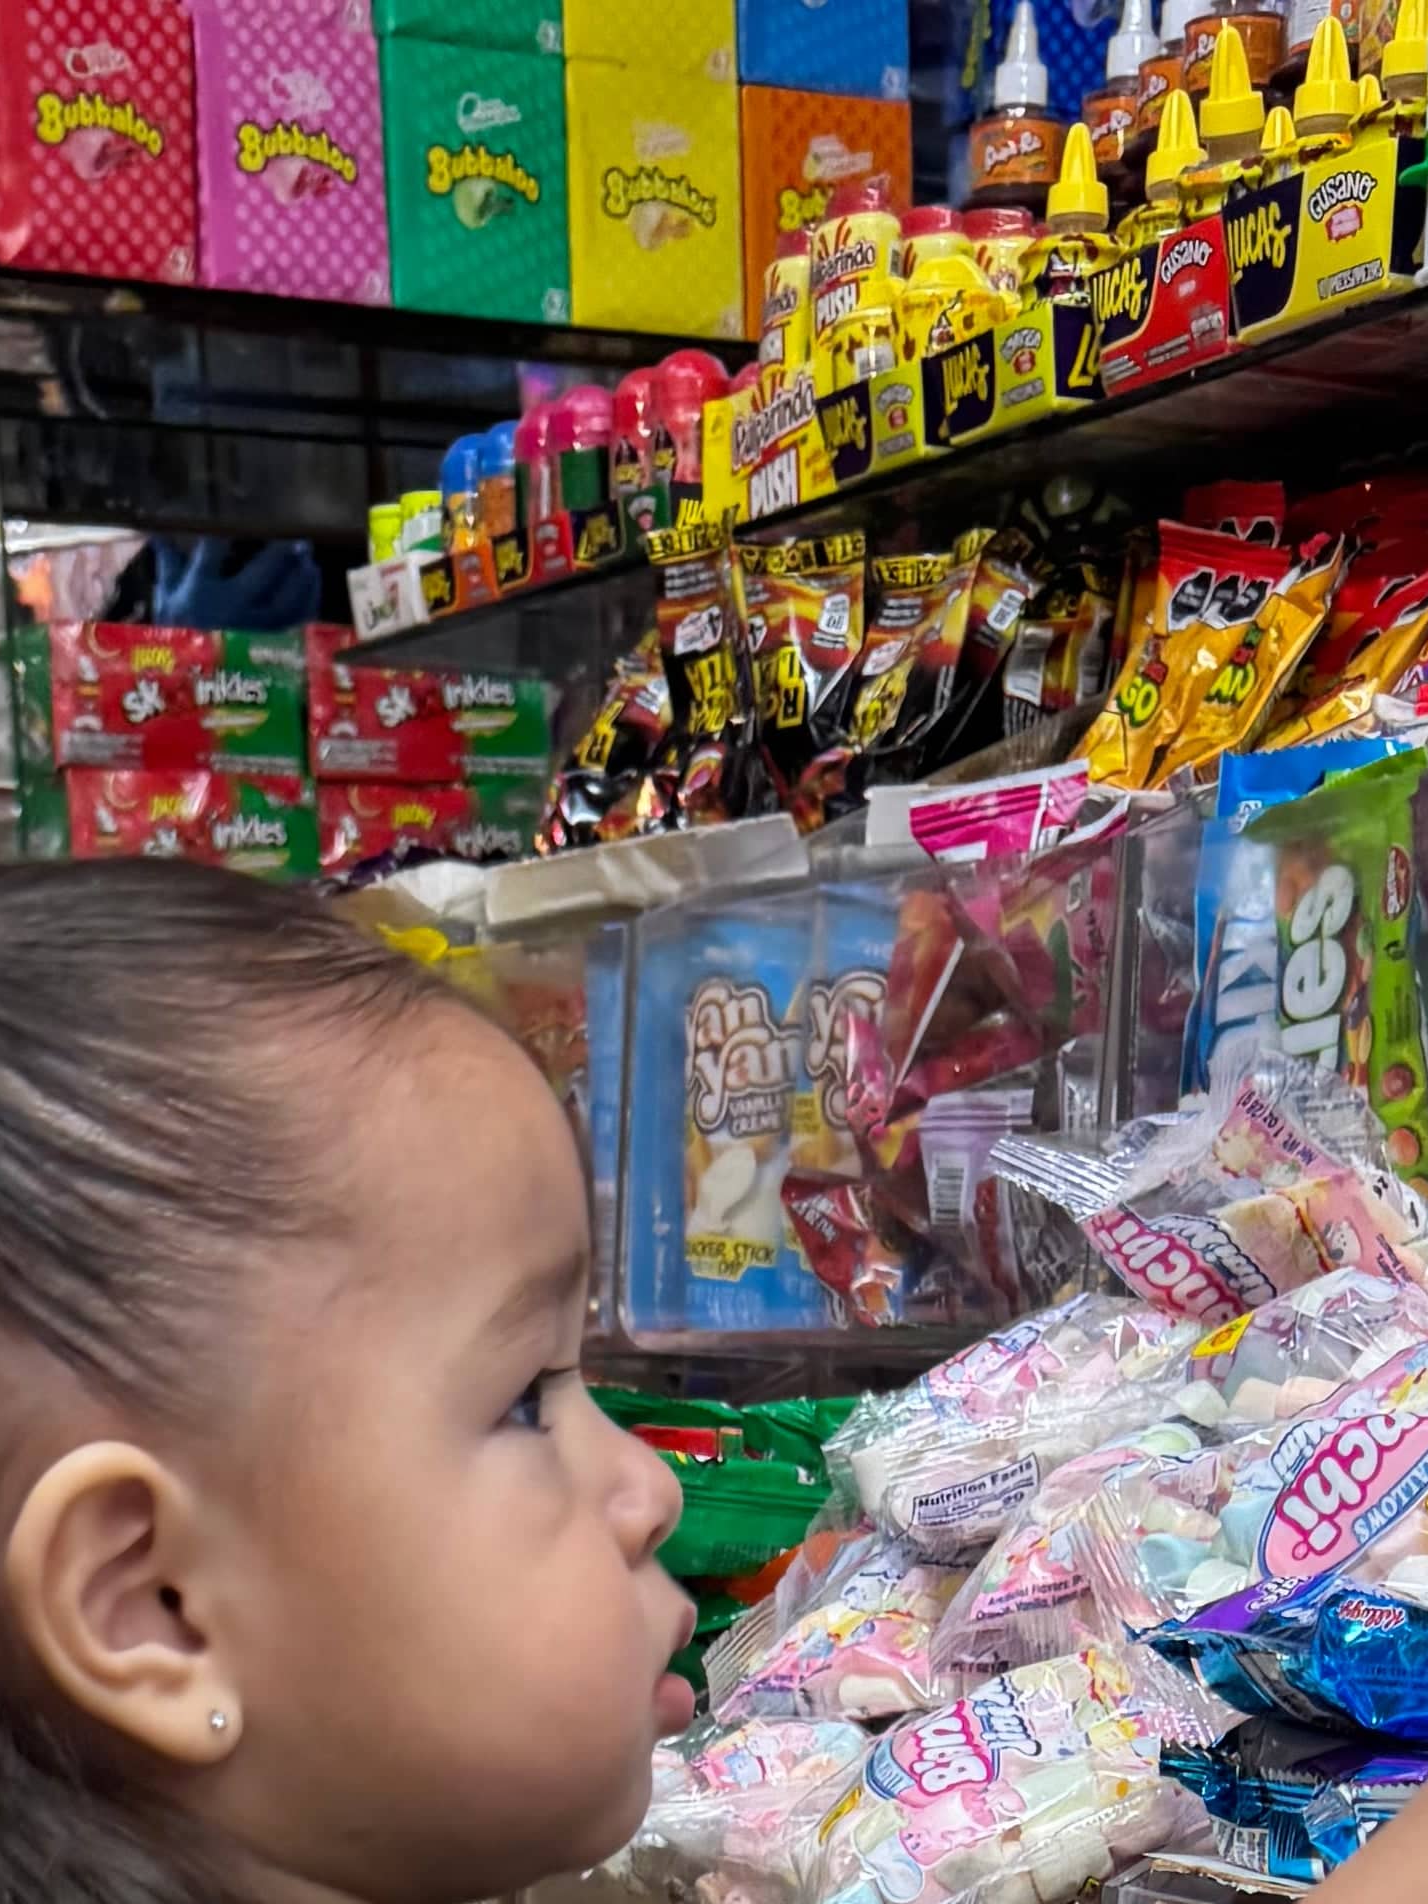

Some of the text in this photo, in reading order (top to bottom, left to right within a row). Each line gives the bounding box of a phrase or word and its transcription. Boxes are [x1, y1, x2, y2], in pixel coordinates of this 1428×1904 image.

[36, 93, 163, 159] Bubbaloo
[236, 122, 358, 184] Bubbaloo
[427, 145, 539, 202] Bubbaloo
[603, 167, 717, 228] Bubbaloo
[1308, 172, 1377, 222] GUSANO
[1161, 240, 1213, 284] GUSANO
[1226, 202, 1292, 285] LUCAS
[1092, 256, 1149, 338] LUCAS
